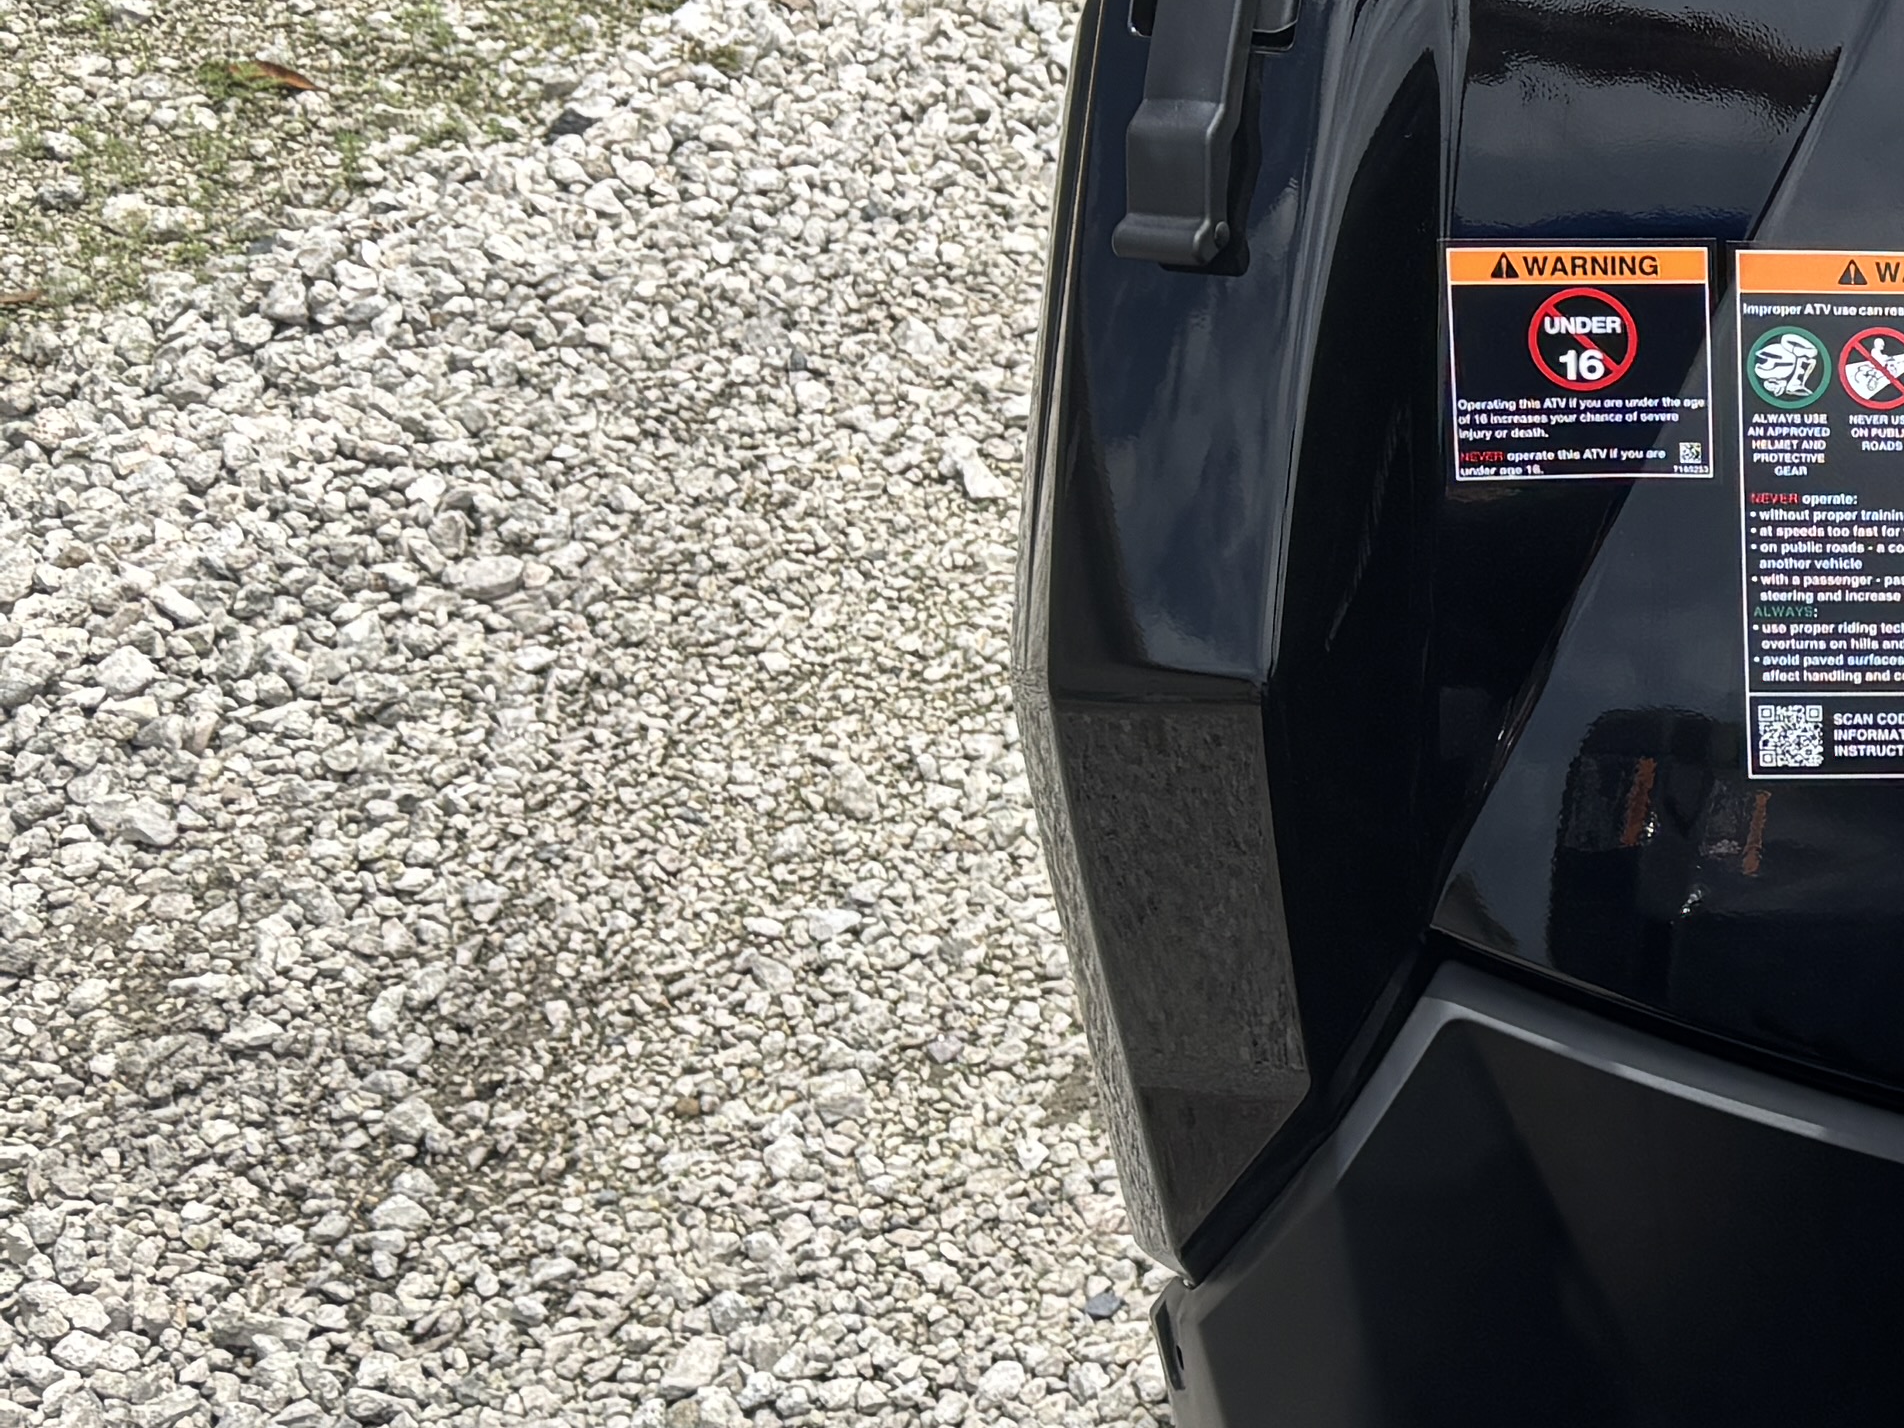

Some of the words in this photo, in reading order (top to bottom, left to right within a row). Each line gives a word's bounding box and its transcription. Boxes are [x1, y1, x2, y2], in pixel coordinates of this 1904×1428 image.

[1522, 256, 1658, 276] WARNING
[1743, 303, 1801, 316] Improper
[1803, 304, 1831, 316] ATV
[1833, 304, 1857, 316] use
[1858, 304, 1882, 316] can
[1544, 316, 1621, 334] UNDER
[1559, 349, 1604, 380] 16
[1457, 399, 1516, 411] Operating
[1518, 399, 1540, 408] this
[1543, 398, 1566, 408] ATV
[1568, 398, 1577, 408] if
[1579, 399, 1600, 410] you
[1625, 398, 1658, 407] under
[1661, 398, 1680, 407] the
[1683, 399, 1704, 409] age
[1753, 605, 1817, 617] ALWAYS:
[1833, 713, 1869, 725] SCAN
